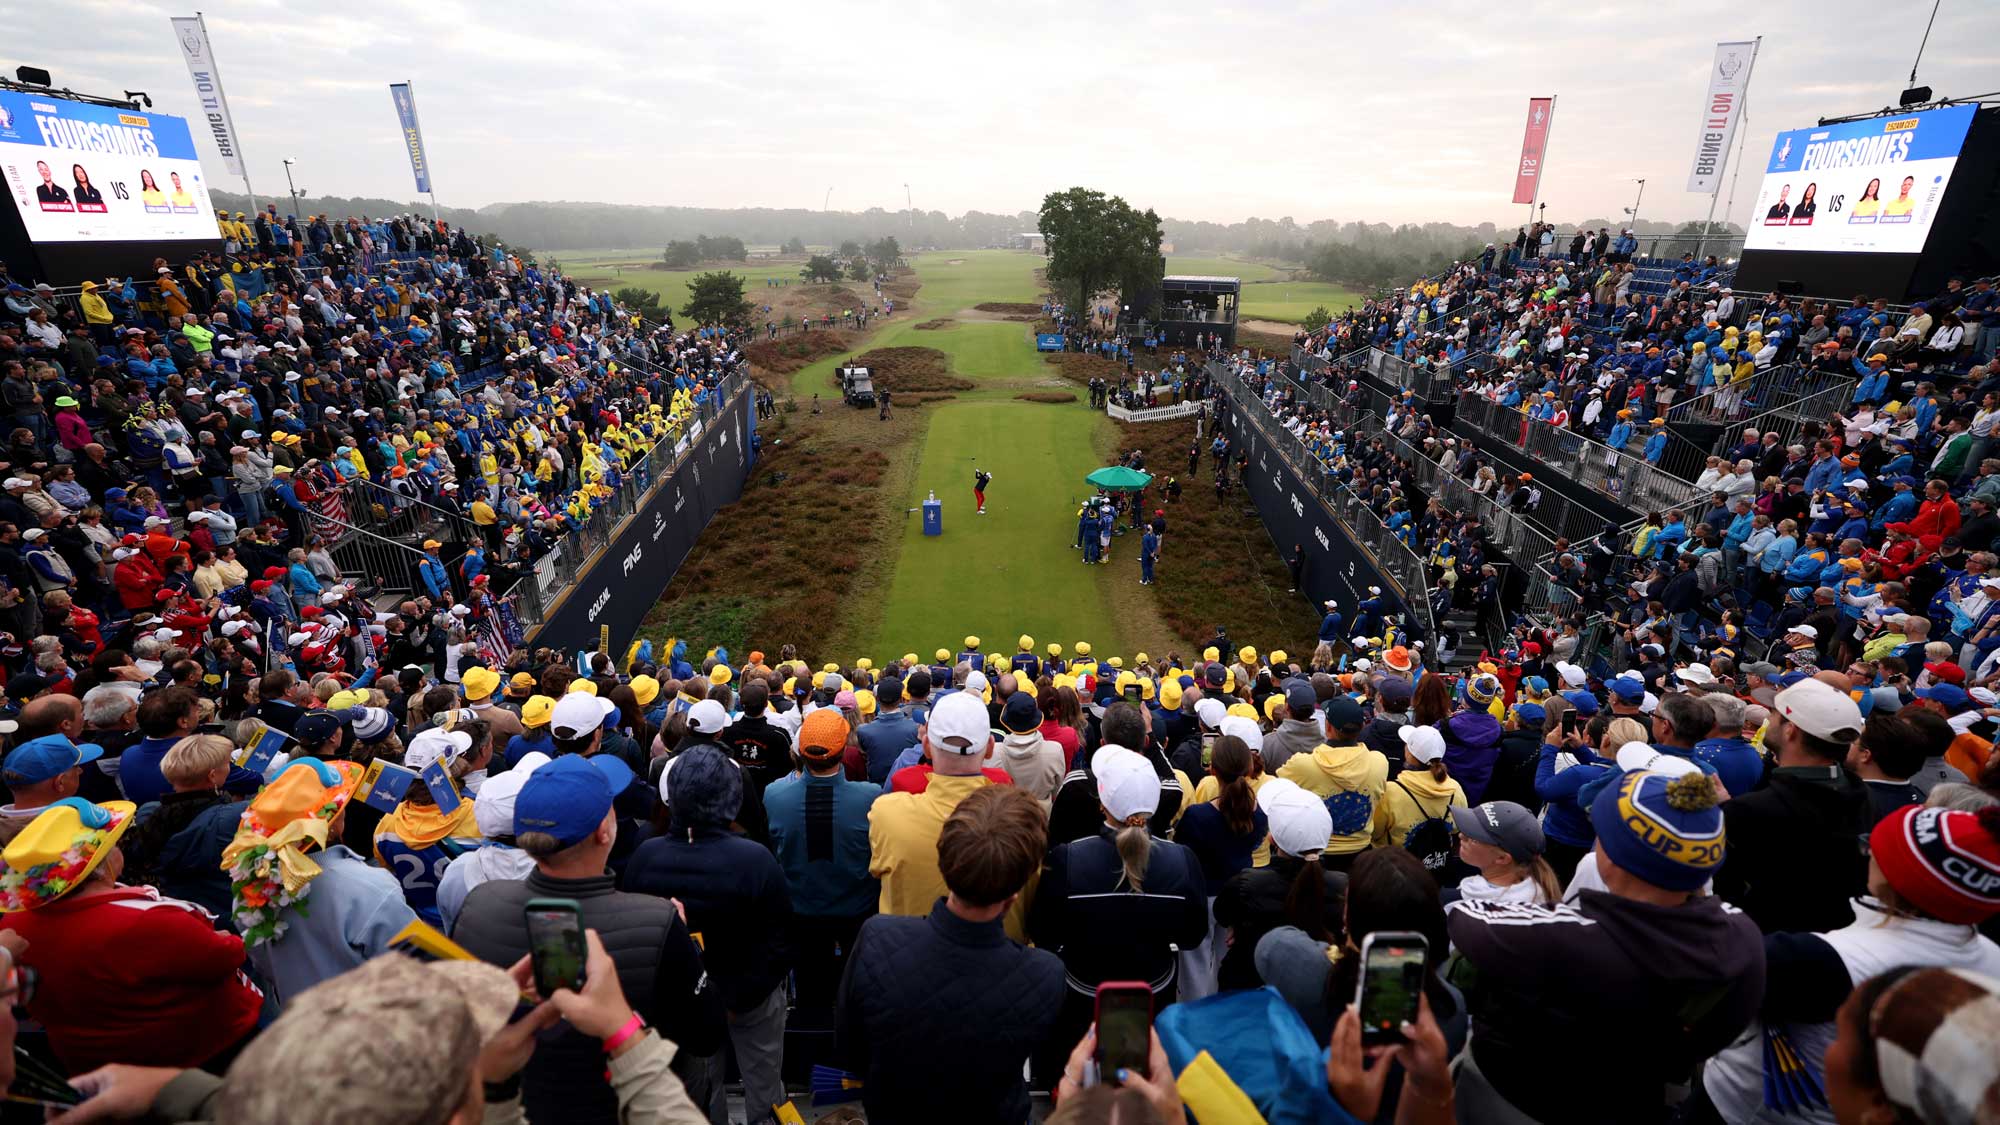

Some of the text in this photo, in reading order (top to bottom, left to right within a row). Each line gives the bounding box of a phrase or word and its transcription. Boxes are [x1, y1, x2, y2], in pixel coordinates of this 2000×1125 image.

[34, 114, 159, 157] FOURSOMES
[1800, 131, 1914, 170] FOURSOMES
[110, 181, 130, 200] VS
[1828, 194, 1845, 212] VS
[1291, 492, 1304, 517] PING
[623, 542, 642, 577] PING
[588, 586, 611, 622] GOLF.NL
[1480, 802, 1499, 827] leist
[1627, 815, 1721, 864] CUP 20
[1942, 857, 2000, 892] CUP
